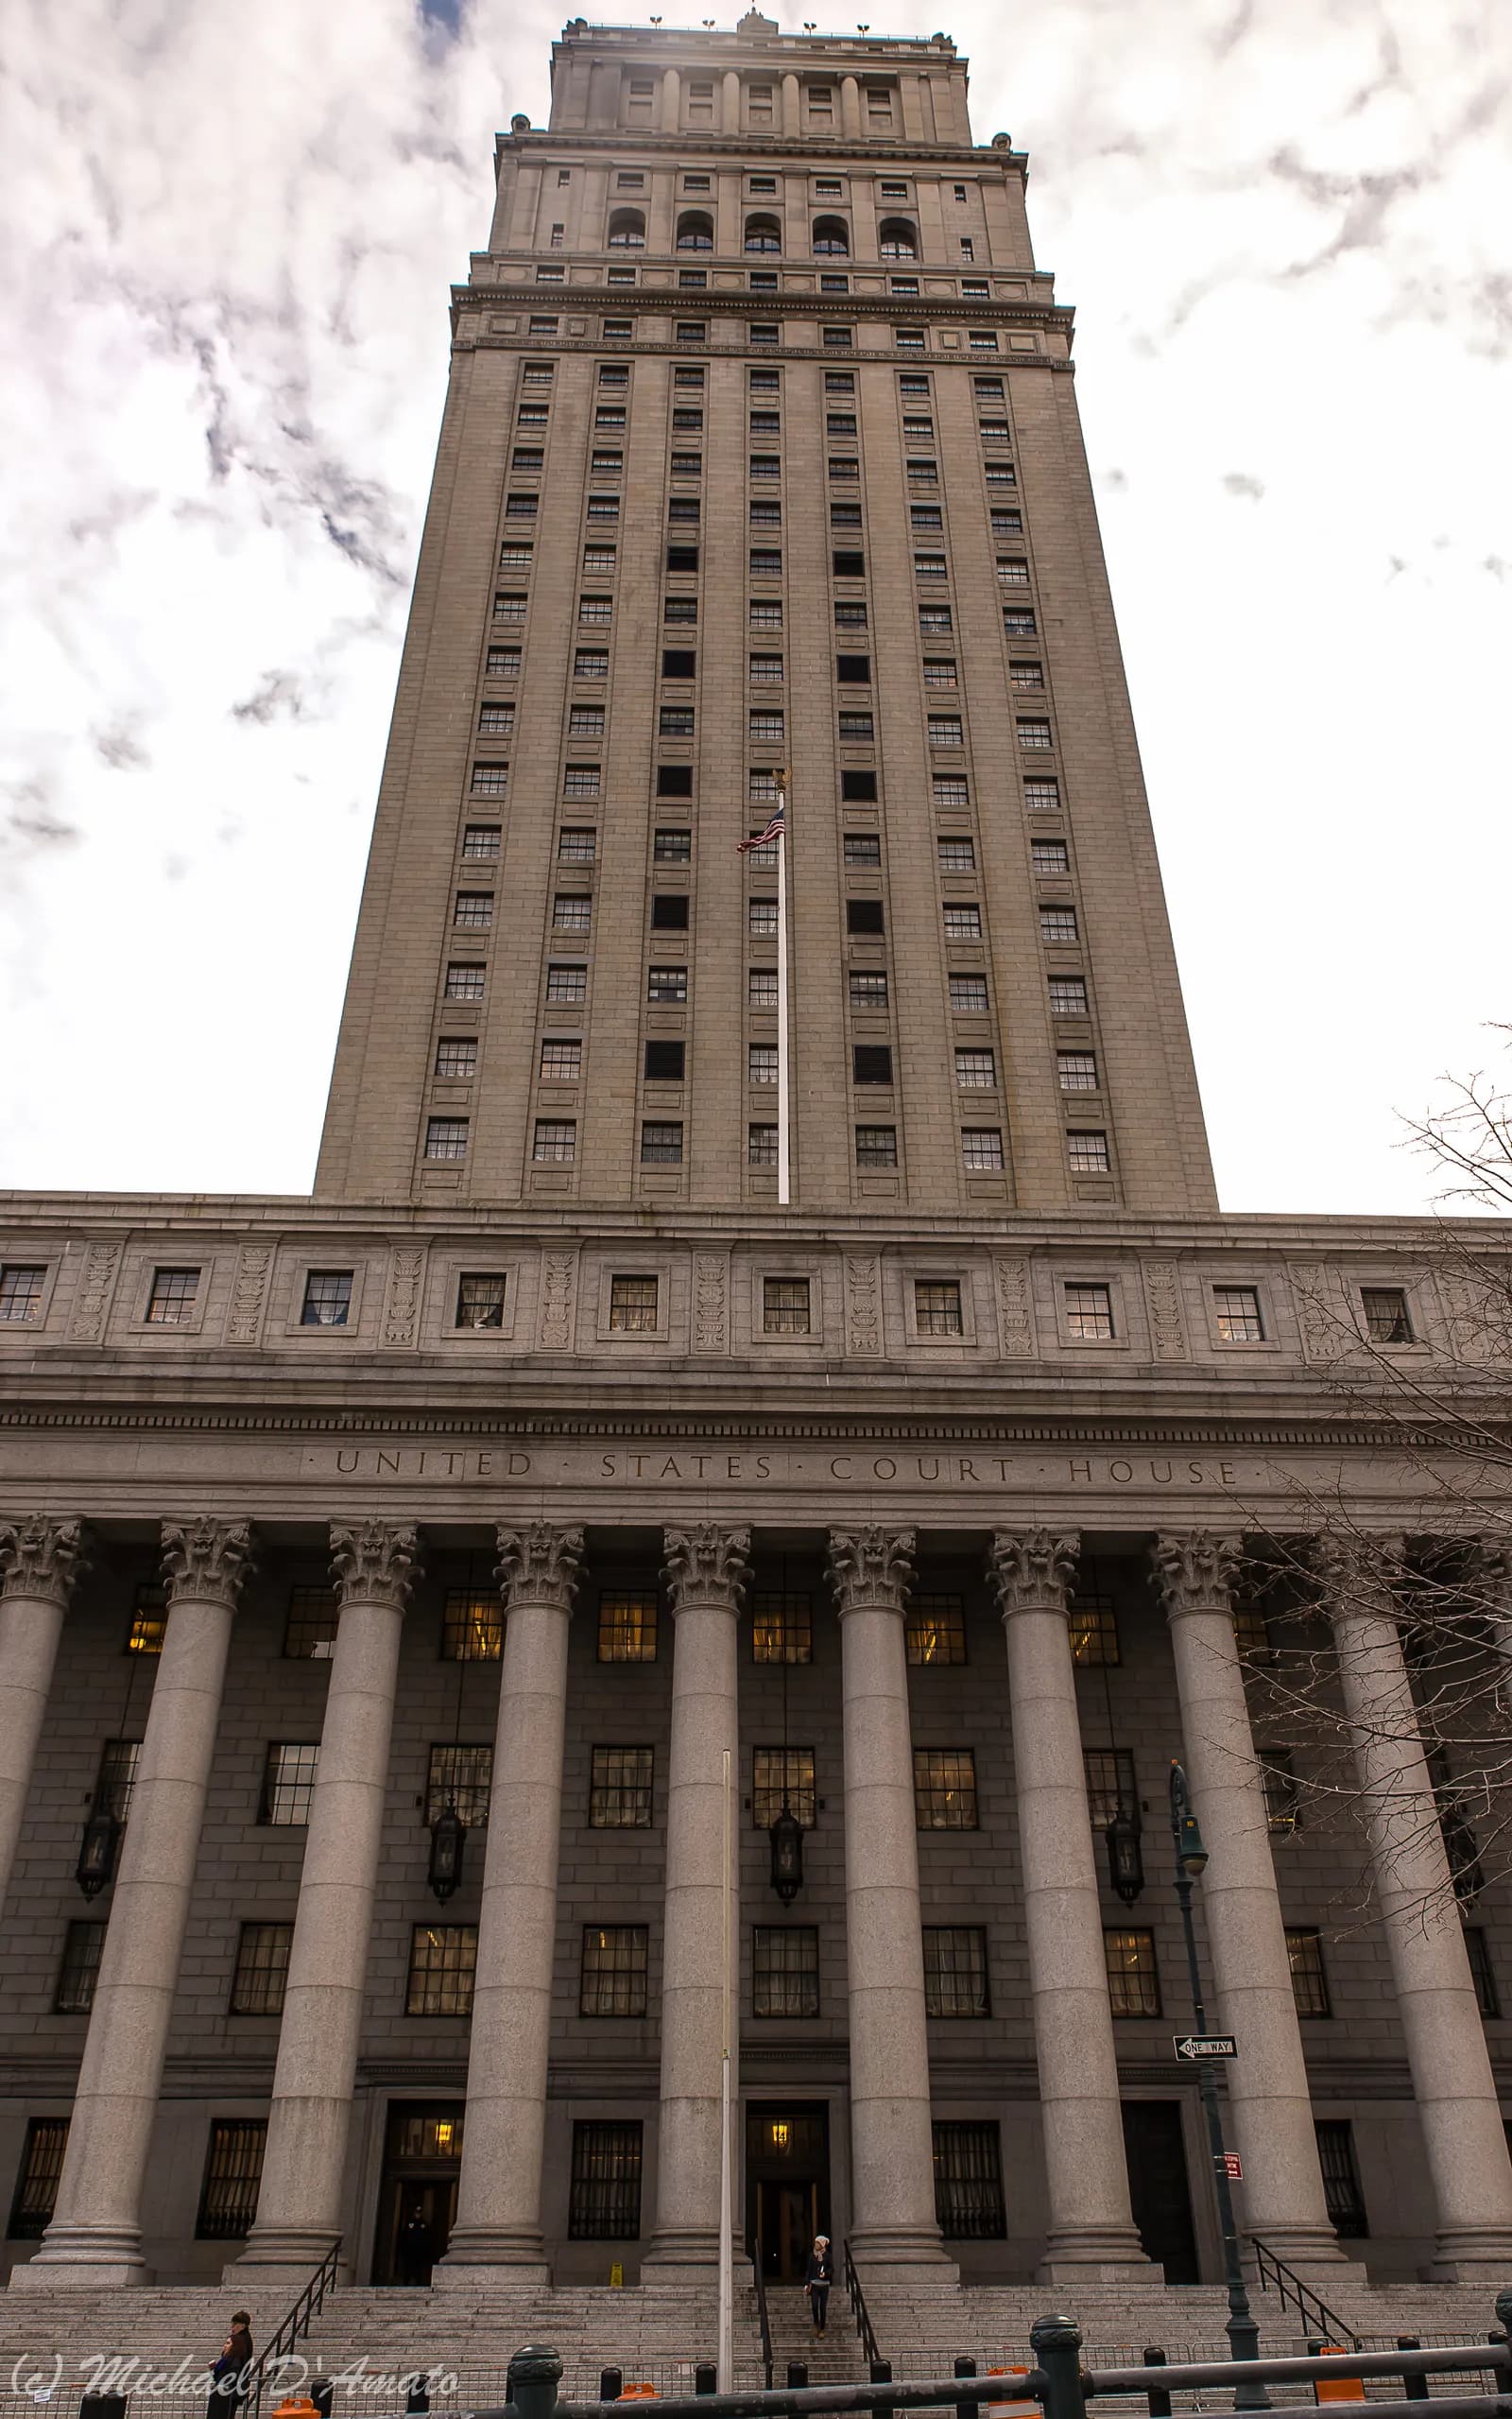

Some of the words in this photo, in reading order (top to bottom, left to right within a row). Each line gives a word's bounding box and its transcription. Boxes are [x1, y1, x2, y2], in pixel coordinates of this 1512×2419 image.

[335, 1450, 532, 1476] UNITED
[600, 1453, 771, 1478] STATES
[830, 1457, 1014, 1482] COURT
[1068, 1459, 1237, 1484] HOUSE
[1185, 2043, 1203, 2052] ONE
[1210, 2041, 1229, 2052] WAY
